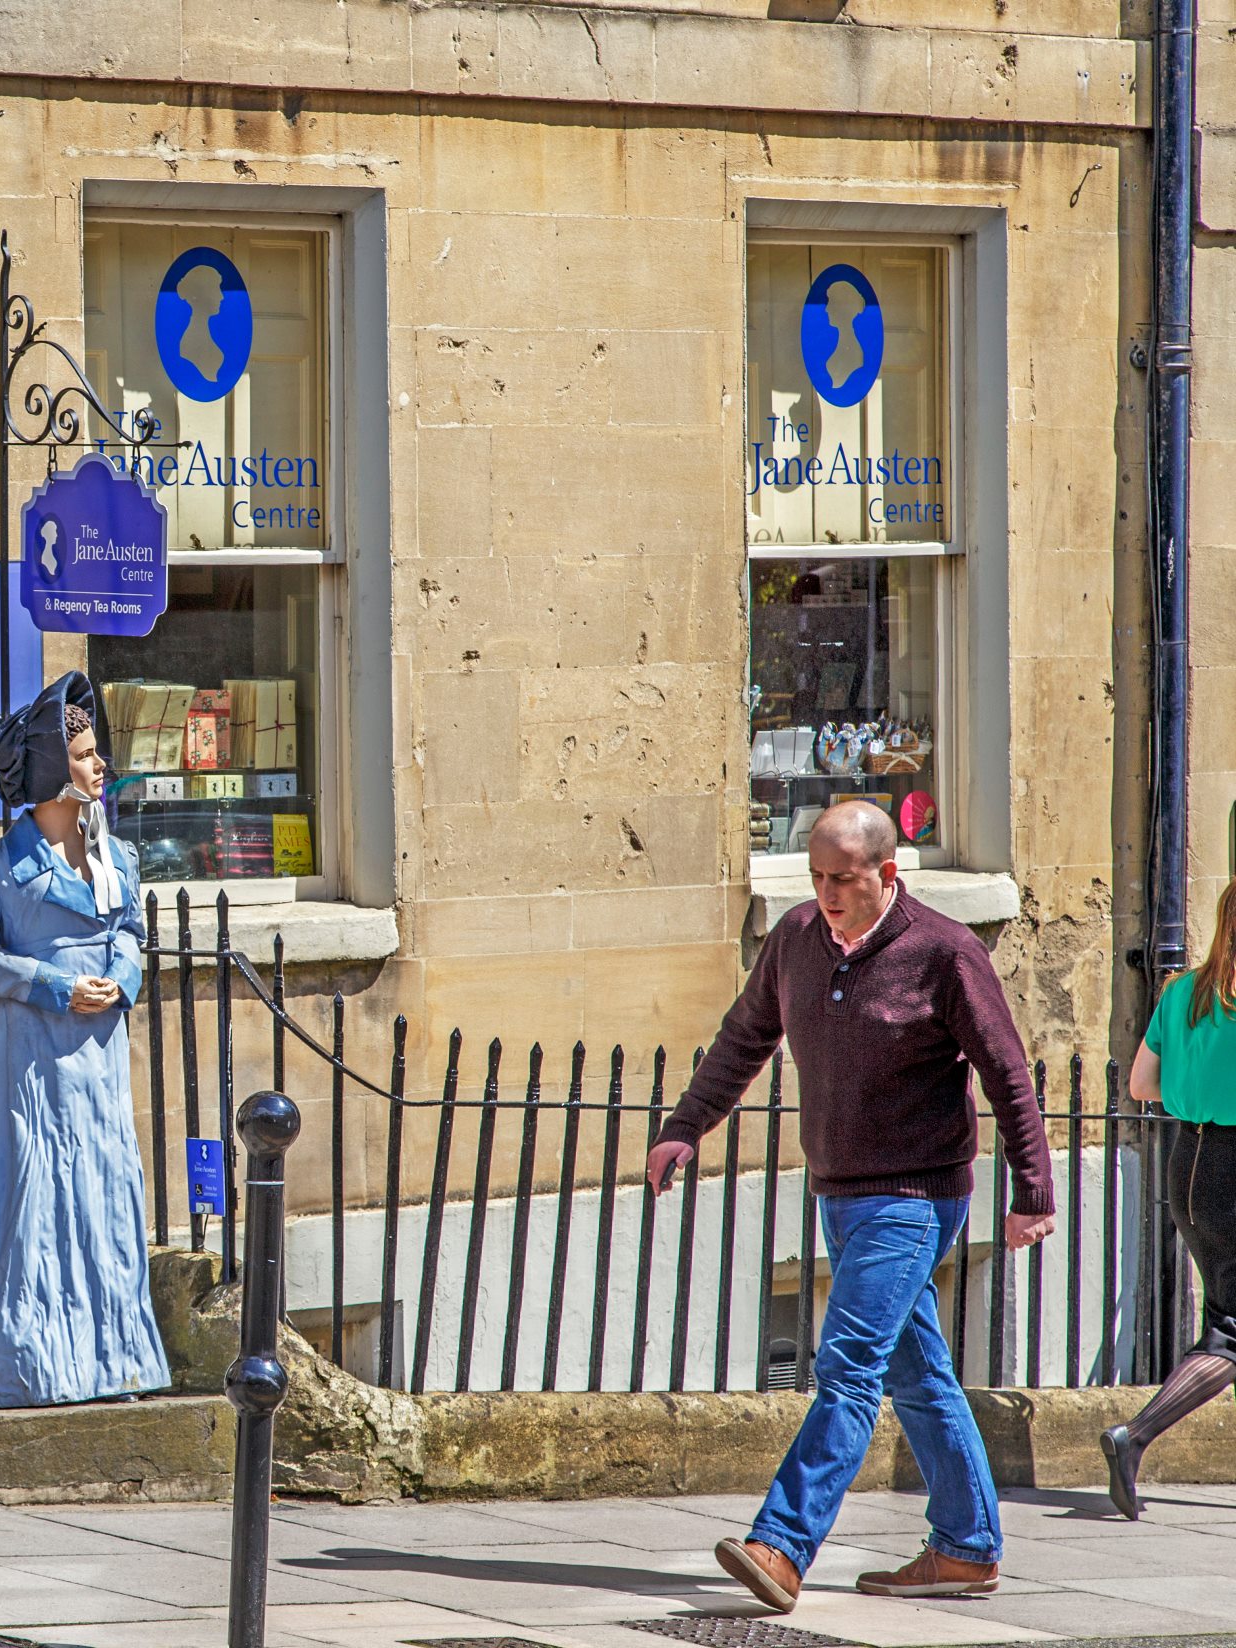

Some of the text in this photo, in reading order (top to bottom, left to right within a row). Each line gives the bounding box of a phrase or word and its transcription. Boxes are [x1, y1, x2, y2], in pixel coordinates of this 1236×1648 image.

[113, 410, 162, 440] The
[767, 416, 809, 443] The
[93, 439, 321, 488] ane Austen
[747, 442, 943, 495] Jane Austen
[232, 500, 321, 529] Centre
[868, 497, 945, 524] Centre
[80, 524, 99, 539] The
[71, 537, 154, 565] Jane Austen
[121, 566, 154, 582] Centre
[44, 597, 142, 616] & Regency Tea Rooms
